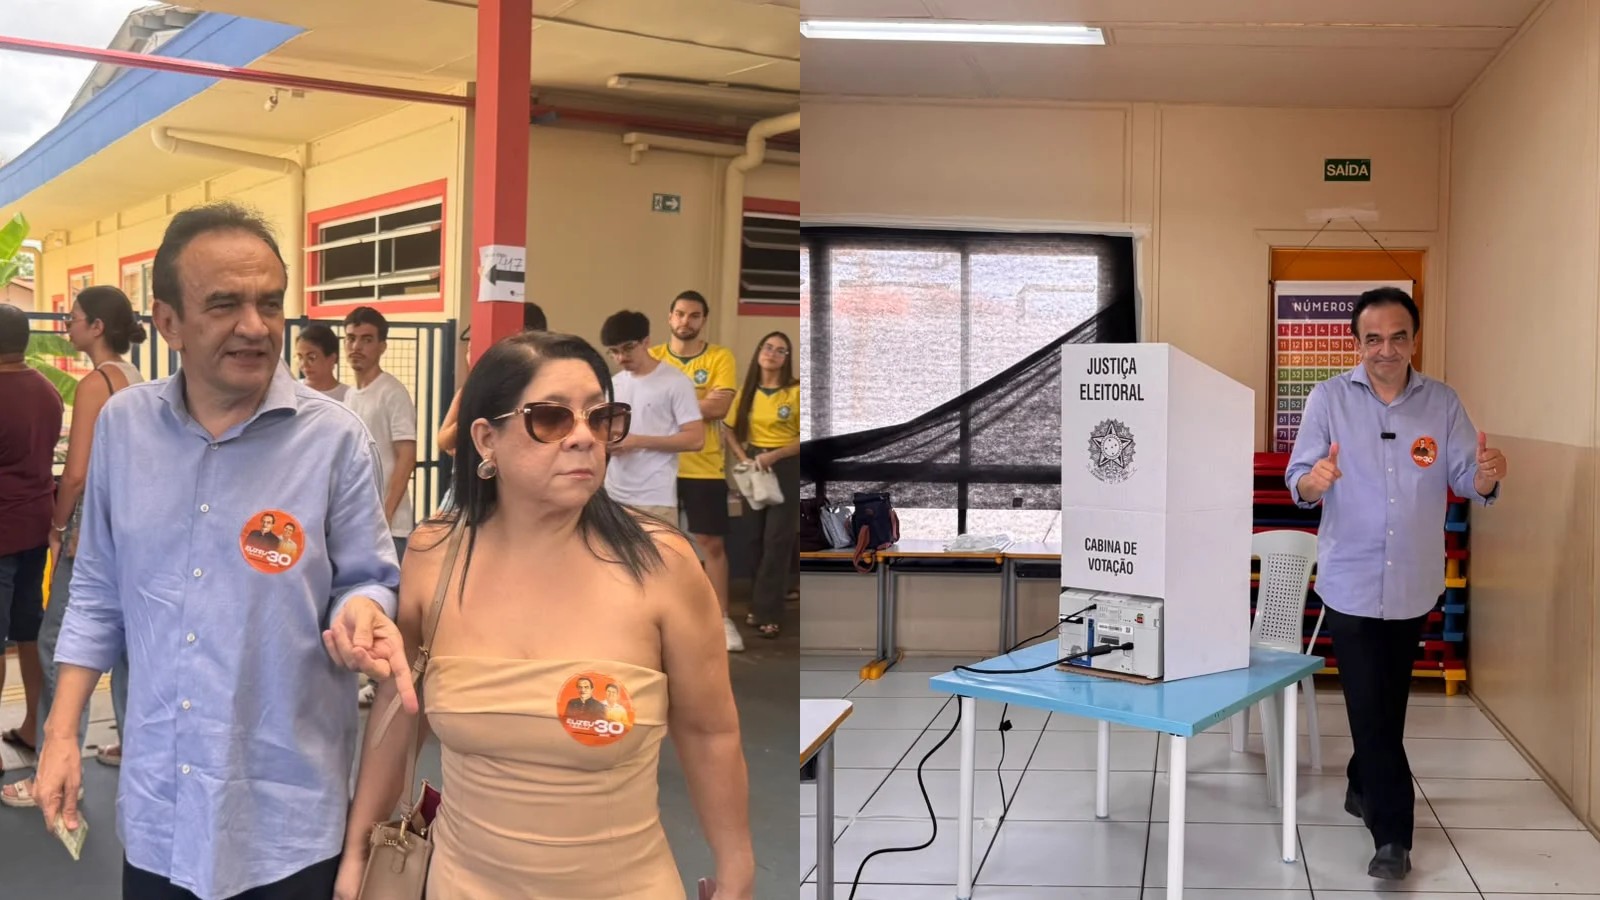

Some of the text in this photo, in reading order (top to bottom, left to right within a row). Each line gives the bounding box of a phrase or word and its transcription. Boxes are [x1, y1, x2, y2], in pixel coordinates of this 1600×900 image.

[1326, 161, 1369, 177] SAÍDA
[1294, 299, 1354, 312] NÚMEROS
[1280, 341, 1353, 349] 11 12 13 14 15 16
[1087, 357, 1137, 379] JUSTIÇA
[1292, 371, 1300, 379] 32
[1305, 371, 1313, 379] 33
[1318, 371, 1327, 379] 34
[1080, 384, 1144, 401] ELEITORAL
[1280, 385, 1287, 393] 41
[1291, 385, 1300, 393] 42
[1280, 400, 1300, 408] 51 52
[1280, 415, 1300, 423] 61 62
[1085, 538, 1137, 556] CABINA DE
[266, 550, 292, 566] 30
[1088, 557, 1134, 576] VOTAÇÃO
[594, 719, 625, 735] 30
